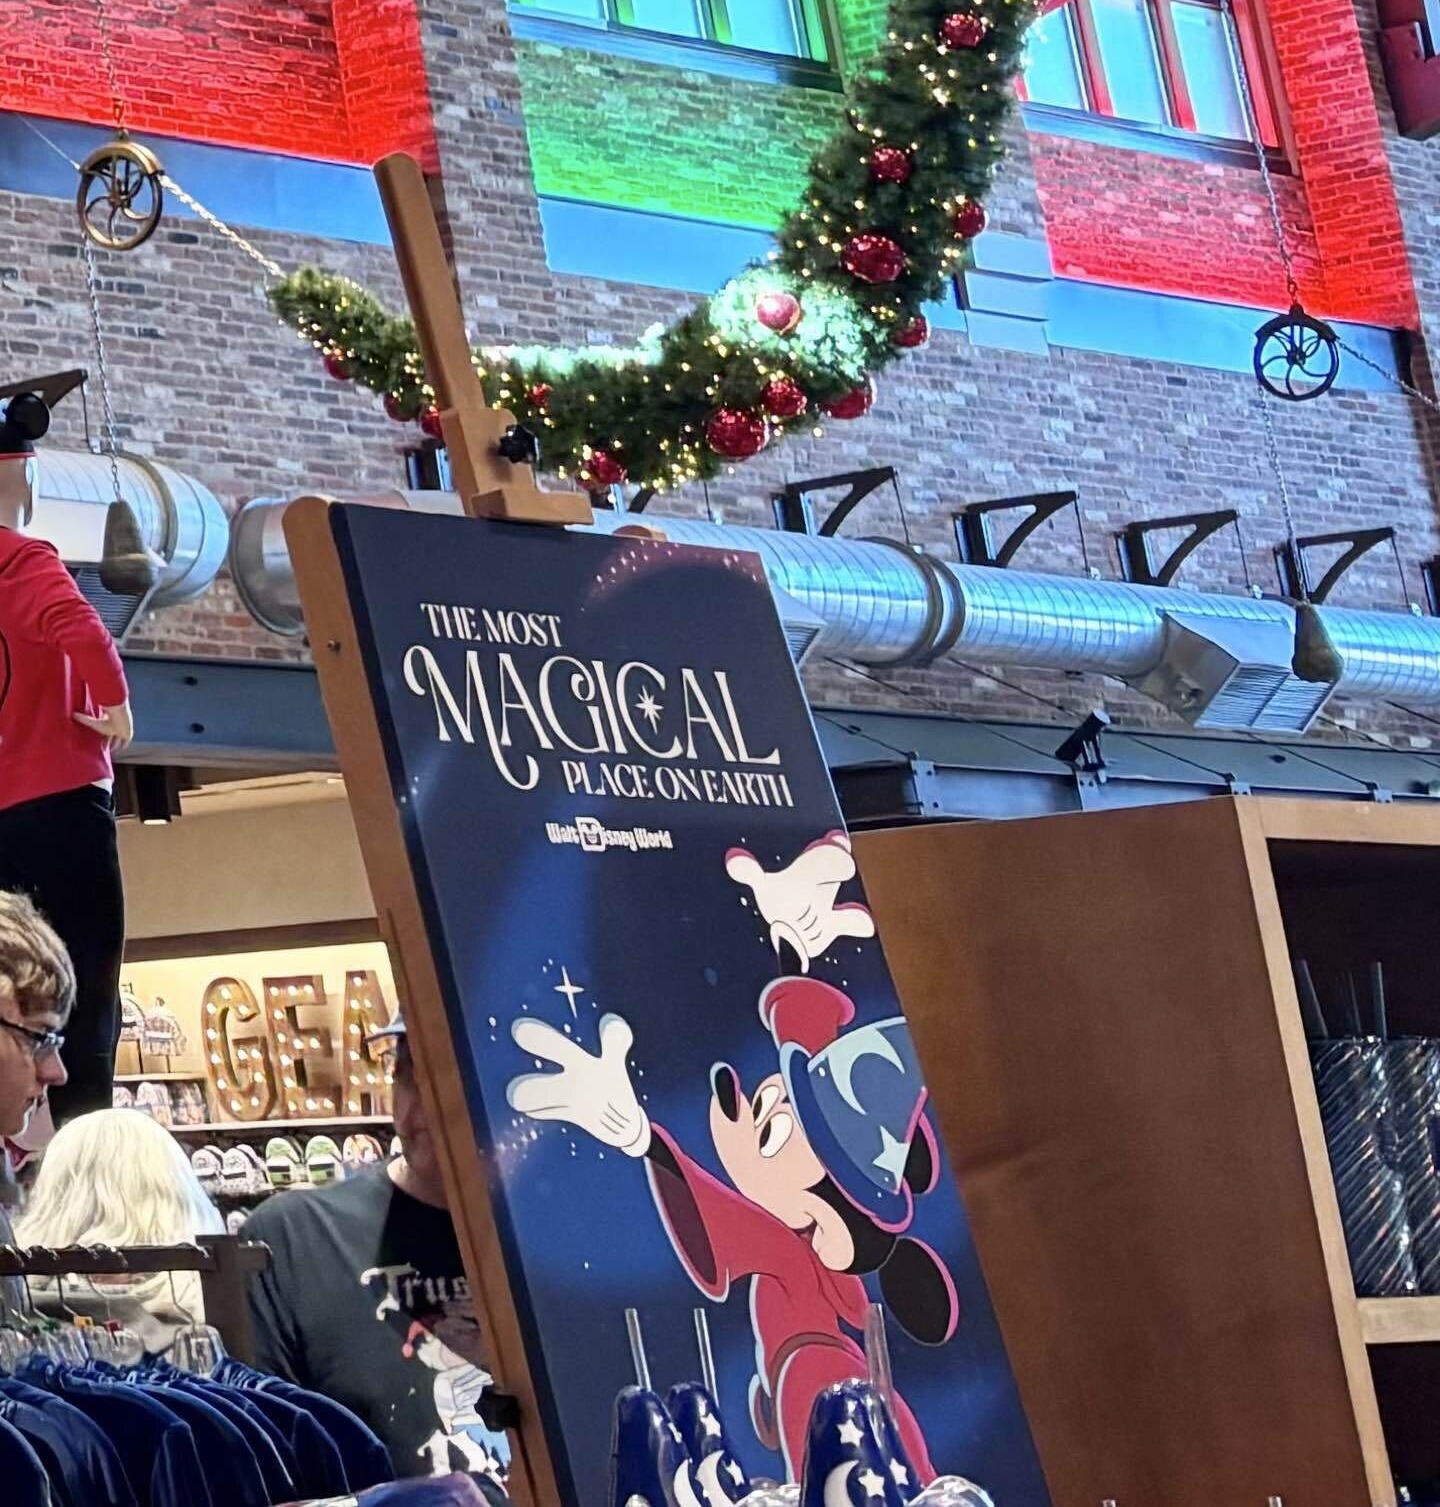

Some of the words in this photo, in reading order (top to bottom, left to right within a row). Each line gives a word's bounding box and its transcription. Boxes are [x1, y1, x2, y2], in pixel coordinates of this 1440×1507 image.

[420, 602, 481, 642] THE
[482, 608, 562, 648] MOST
[403, 644, 781, 791] MAGICAL
[561, 760, 654, 799] PLACE
[654, 766, 704, 802] ON
[701, 769, 795, 808] EARTH
[545, 822, 580, 844] Walt
[574, 816, 638, 852] Disney
[633, 827, 674, 849] World
[201, 970, 393, 1122] GEA
[360, 1262, 472, 1321] Trus
